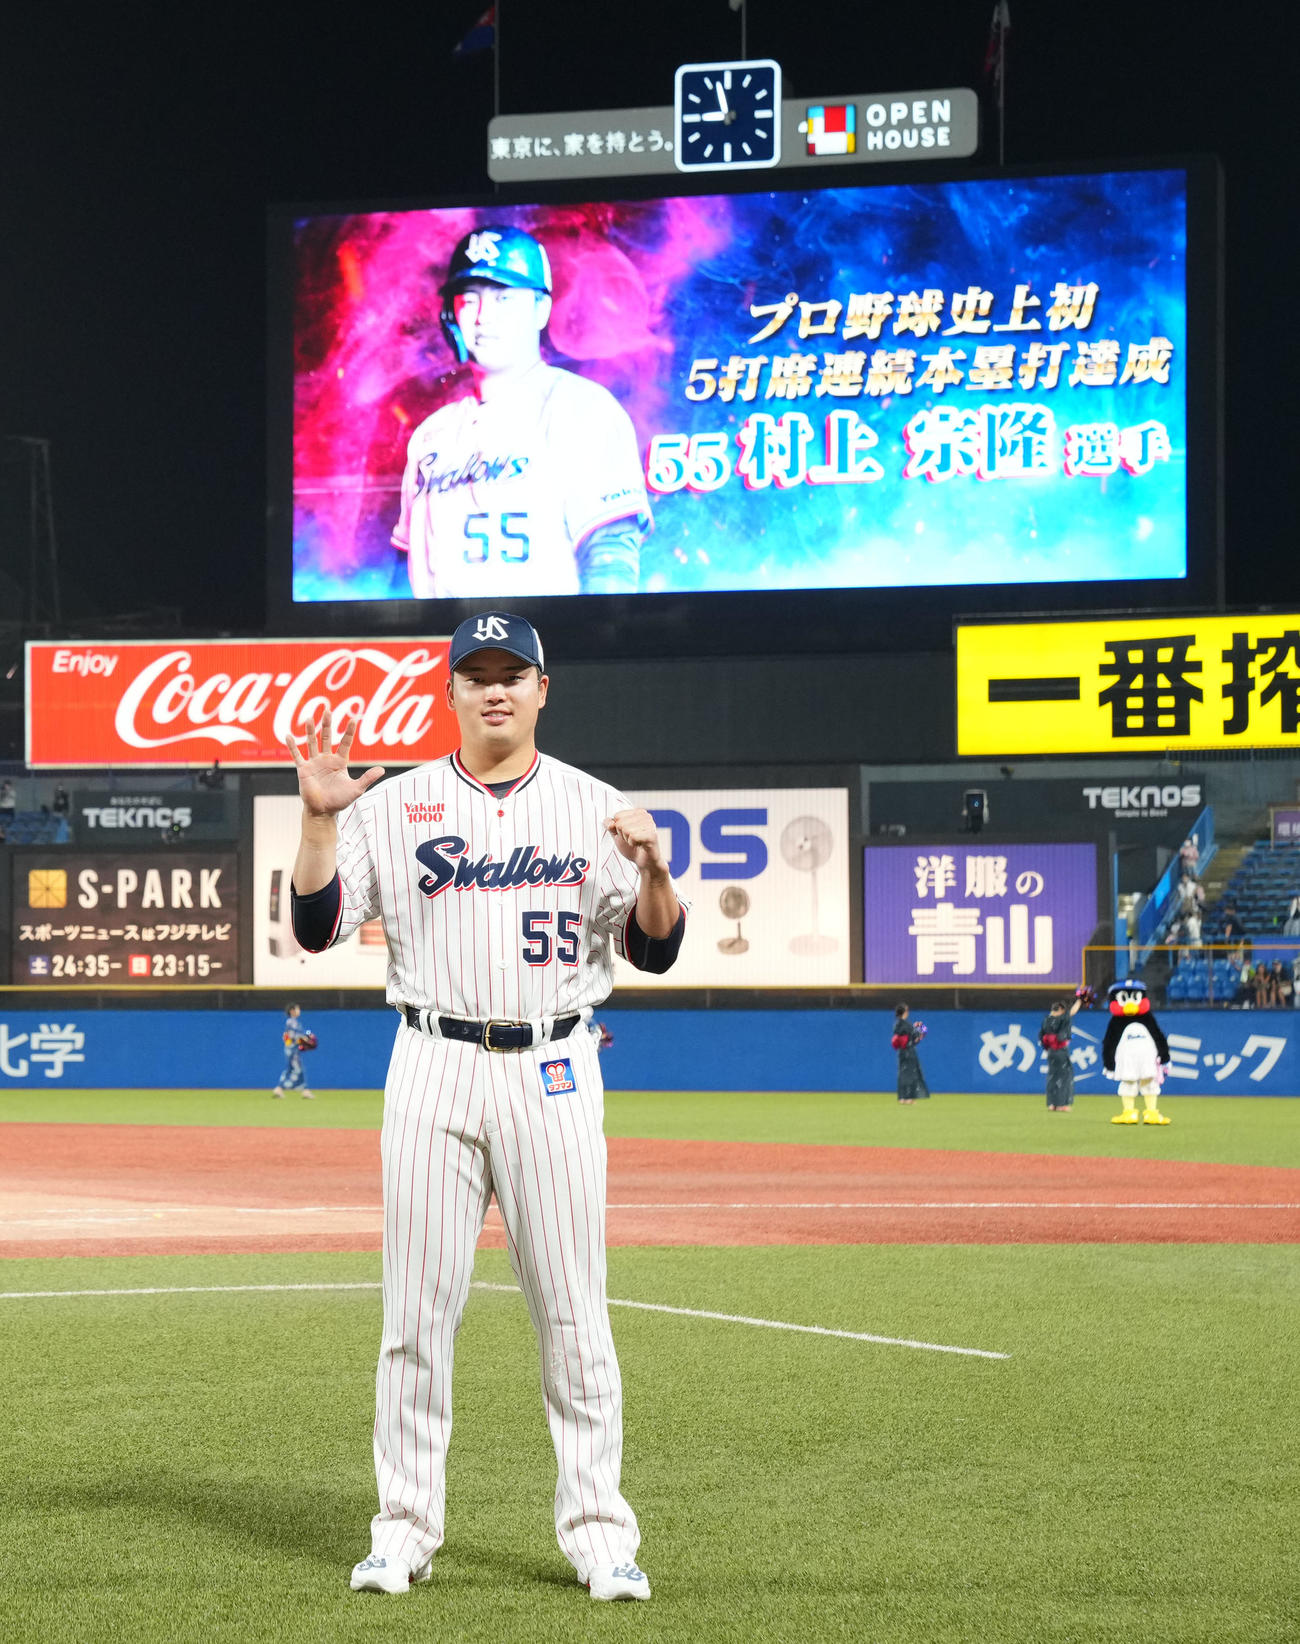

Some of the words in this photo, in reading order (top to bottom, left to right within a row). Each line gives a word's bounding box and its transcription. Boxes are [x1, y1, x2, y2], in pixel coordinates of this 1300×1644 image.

[866, 99, 952, 127] OPEN
[491, 129, 674, 160] 東京に、家を持とう。
[867, 126, 951, 150] HOUSE
[748, 281, 1099, 345] プロ野球史上初
[684, 336, 1174, 402] 5打席連続本塁打達成
[413, 451, 529, 499] Swallows
[645, 431, 732, 494] 55
[463, 512, 529, 563] 55
[51, 649, 119, 677] Enjoy
[114, 648, 448, 749] Coca-Cola
[404, 802, 445, 815] Yakult
[407, 812, 443, 824] 1000
[1082, 784, 1201, 809] TEKNOS
[78, 868, 222, 909] S-PARK
[415, 835, 590, 899] Swallows
[914, 854, 1044, 899] 洋服の
[18, 922, 232, 942] スポーツニュースはフジテレビ
[521, 910, 583, 967] 55
[908, 902, 1053, 975] 青山
